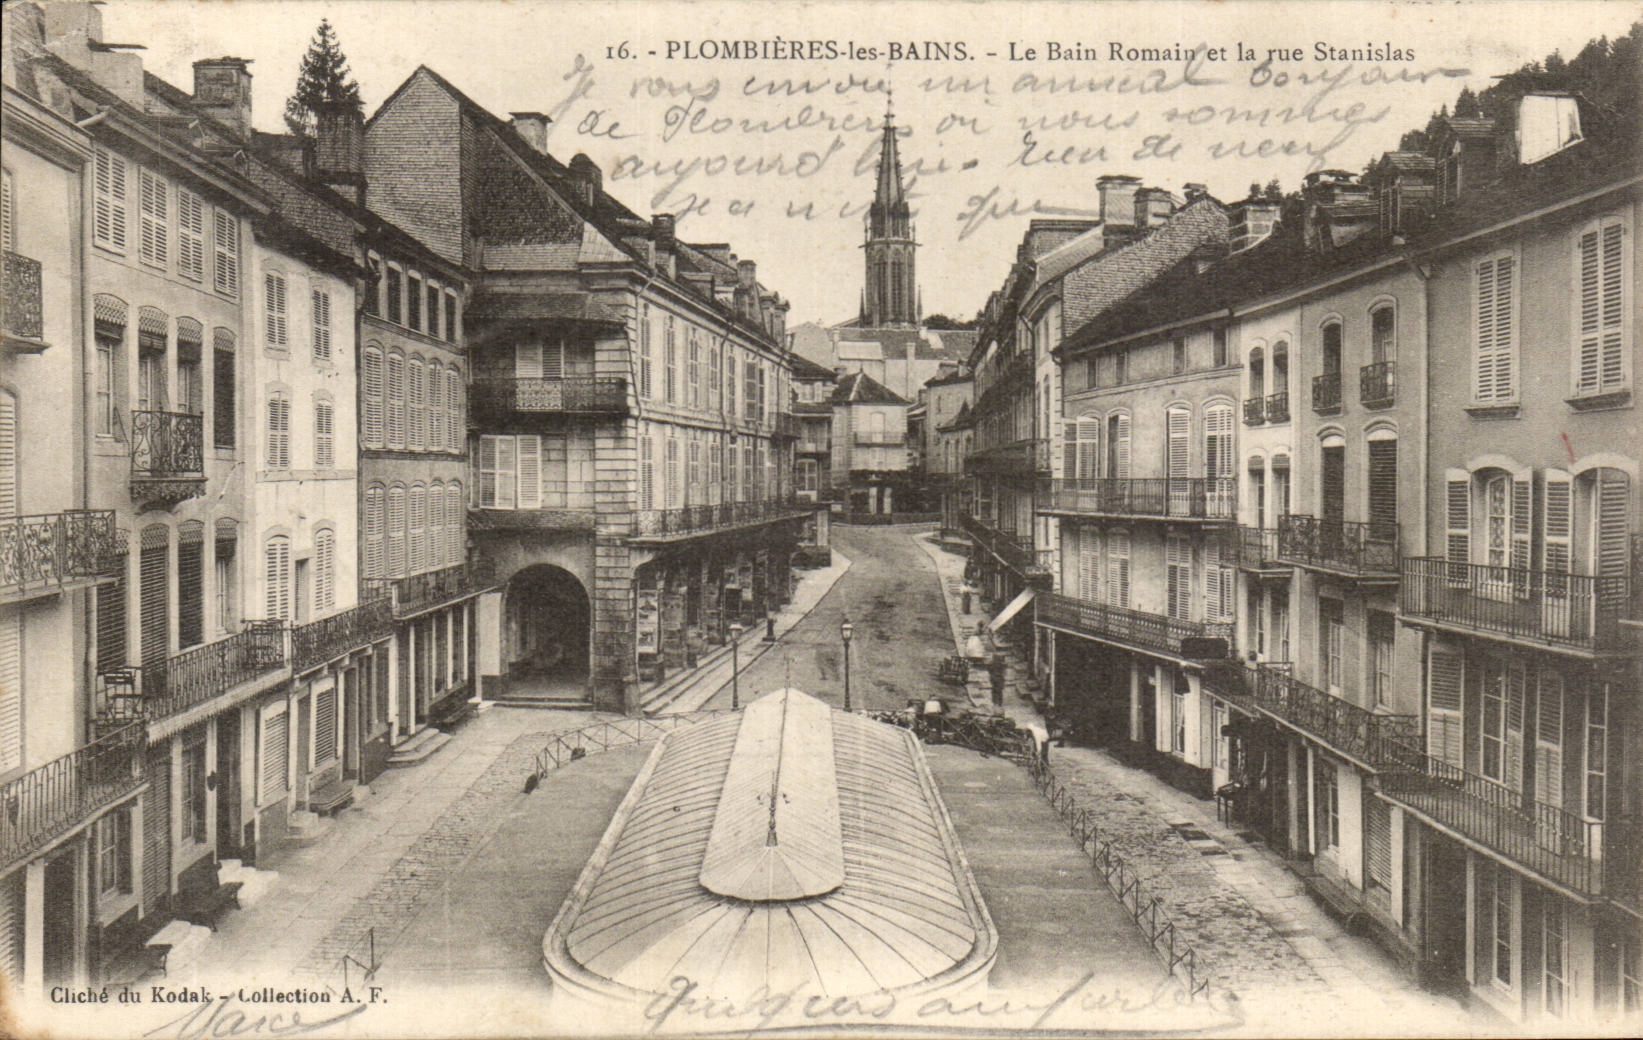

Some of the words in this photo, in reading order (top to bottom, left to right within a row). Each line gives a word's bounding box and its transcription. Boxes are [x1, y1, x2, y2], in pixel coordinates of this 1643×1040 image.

[577, 110, 641, 140] de
[1017, 109, 1141, 131] nous
[1132, 133, 1184, 162] de
